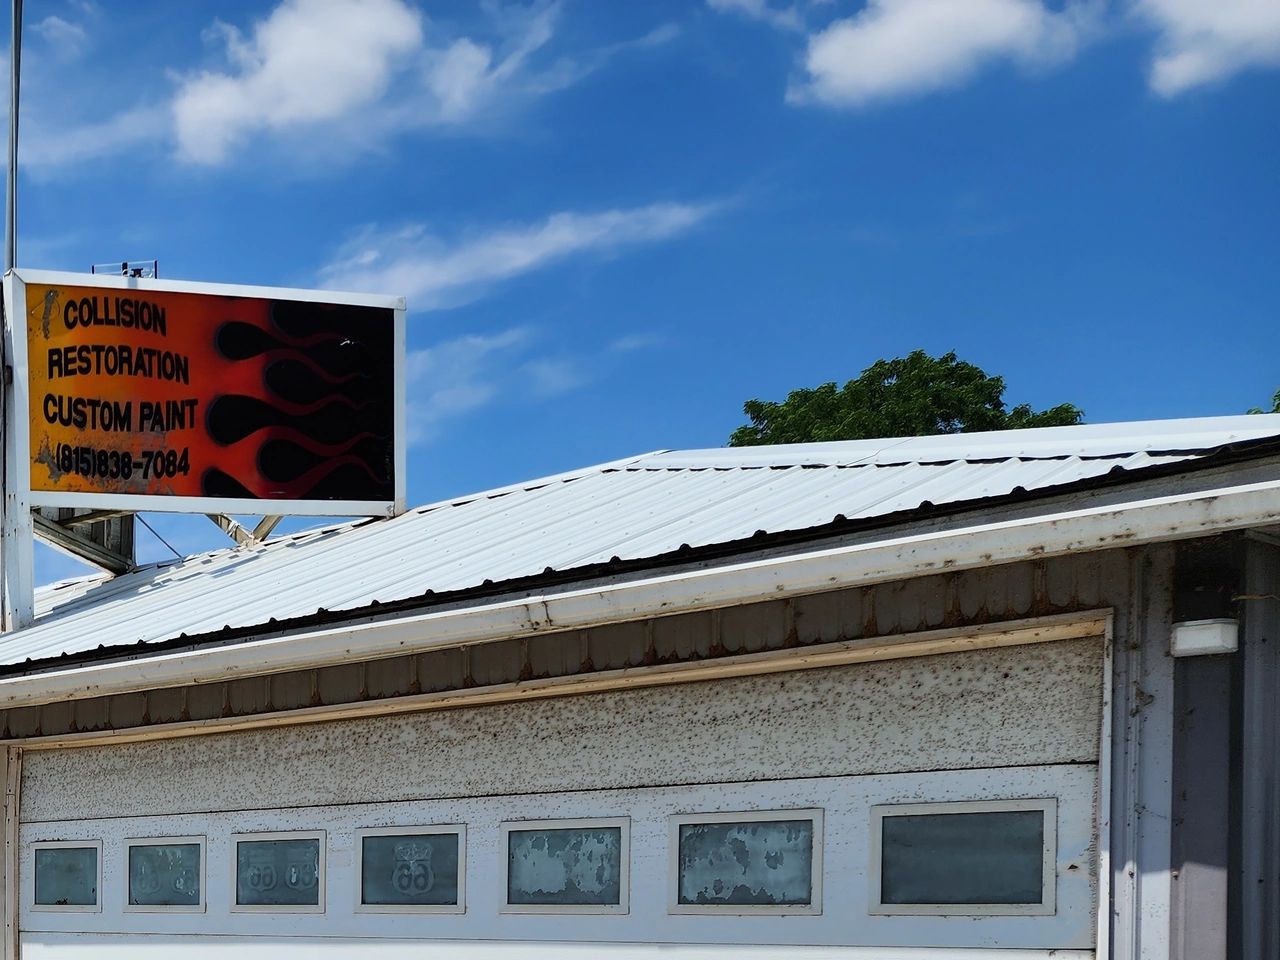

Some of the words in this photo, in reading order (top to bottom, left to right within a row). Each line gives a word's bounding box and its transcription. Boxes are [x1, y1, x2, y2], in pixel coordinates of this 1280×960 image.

[63, 296, 167, 337] COLLISION
[48, 344, 190, 386] RESTORATION
[43, 393, 132, 432] CUSTOM
[139, 398, 199, 433] PAINT
[56, 442, 191, 480] (815)838-7084
